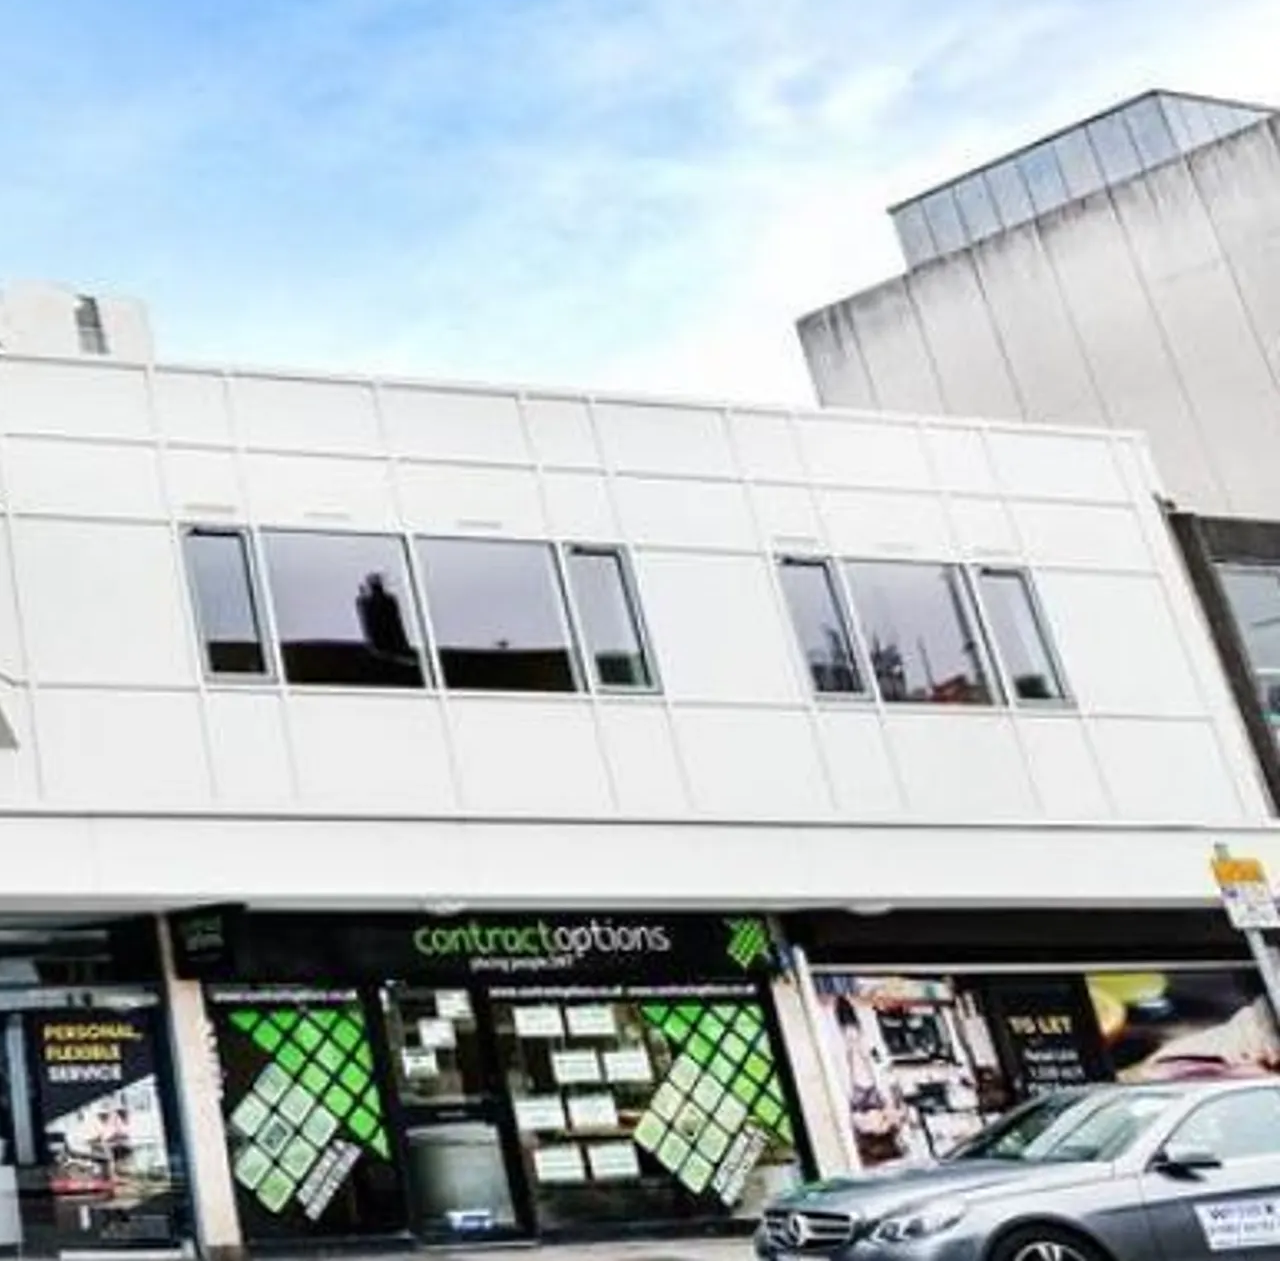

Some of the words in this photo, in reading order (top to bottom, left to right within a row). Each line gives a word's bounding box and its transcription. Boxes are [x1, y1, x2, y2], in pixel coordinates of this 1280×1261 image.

[413, 919, 670, 958] contractoptions
[1007, 1015, 1037, 1035] TO
[1037, 1015, 1072, 1035] LET
[44, 1043, 122, 1061] FLEXIBLE
[47, 1064, 122, 1082] SERVICE
